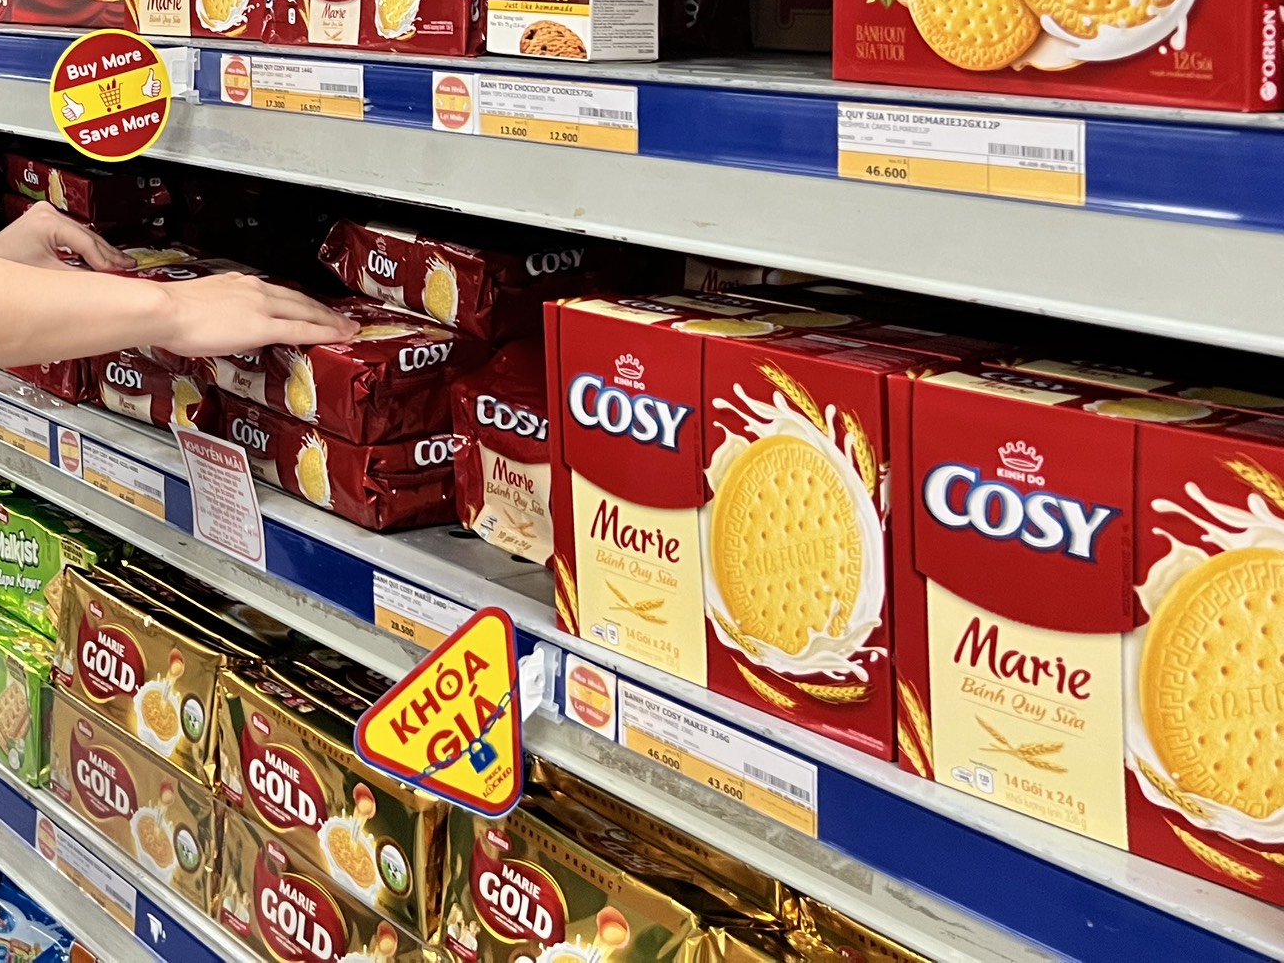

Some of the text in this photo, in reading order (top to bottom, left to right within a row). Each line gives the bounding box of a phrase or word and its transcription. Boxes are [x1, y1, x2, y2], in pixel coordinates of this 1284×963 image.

[322, 6, 347, 20] Marie
[504, 2, 519, 11] Just
[535, 3, 574, 14] homemade
[1262, 9, 1276, 78] ORION
[66, 47, 143, 82] Buy More
[480, 81, 497, 89] BANH
[498, 82, 513, 91] TIPO
[514, 83, 551, 95] CHOCOCHIP
[552, 86, 594, 98] COOKIES75G
[79, 110, 161, 145] Save More
[500, 126, 527, 137] 13.600
[550, 131, 578, 143] 12.900
[866, 111, 885, 122] SUA
[887, 113, 911, 124] TUOI
[912, 115, 1001, 130] DEMARIE32GX12P
[866, 165, 908, 180] 46.600
[368, 252, 398, 280] COSY
[525, 248, 585, 277] COSY
[398, 342, 454, 373] COSY
[105, 360, 143, 391] COSY
[614, 377, 630, 388] KINH
[476, 395, 549, 439] COSY
[568, 374, 691, 451] COSY
[231, 419, 270, 454] COSY
[493, 456, 534, 494] Marie
[996, 467, 1025, 483] KINH
[923, 464, 1115, 561] COSY
[591, 499, 680, 564] Marie
[16, 573, 42, 591] Kopyor
[595, 550, 678, 590] Bánh Quy Sữa
[98, 630, 126, 658] MARIE
[625, 626, 635, 640] 14
[636, 629, 651, 646] Gói
[660, 636, 672, 652] 24
[674, 642, 680, 657] g
[954, 616, 1092, 700] Marie
[82, 640, 136, 692] GOLD
[389, 648, 490, 745] KHÓA
[960, 675, 1086, 731] Bánh Quy Sữa
[426, 682, 508, 770] GIÁ
[624, 690, 731, 744] BANH QUY COSY MARIE 336G
[89, 751, 117, 779] MARIE
[265, 749, 300, 782] MARIE
[647, 747, 680, 770] 46.000
[76, 760, 131, 816] GOLD
[248, 760, 317, 826] GOLD
[707, 776, 743, 801] 43.600
[1003, 770, 1020, 789] 14
[1023, 776, 1044, 799] Gói
[1056, 789, 1075, 808] 24
[1077, 800, 1086, 815] g
[279, 873, 317, 912] MARIE
[501, 863, 541, 901] MARIE
[478, 871, 554, 939] GOLD
[261, 888, 333, 960] GOLD
